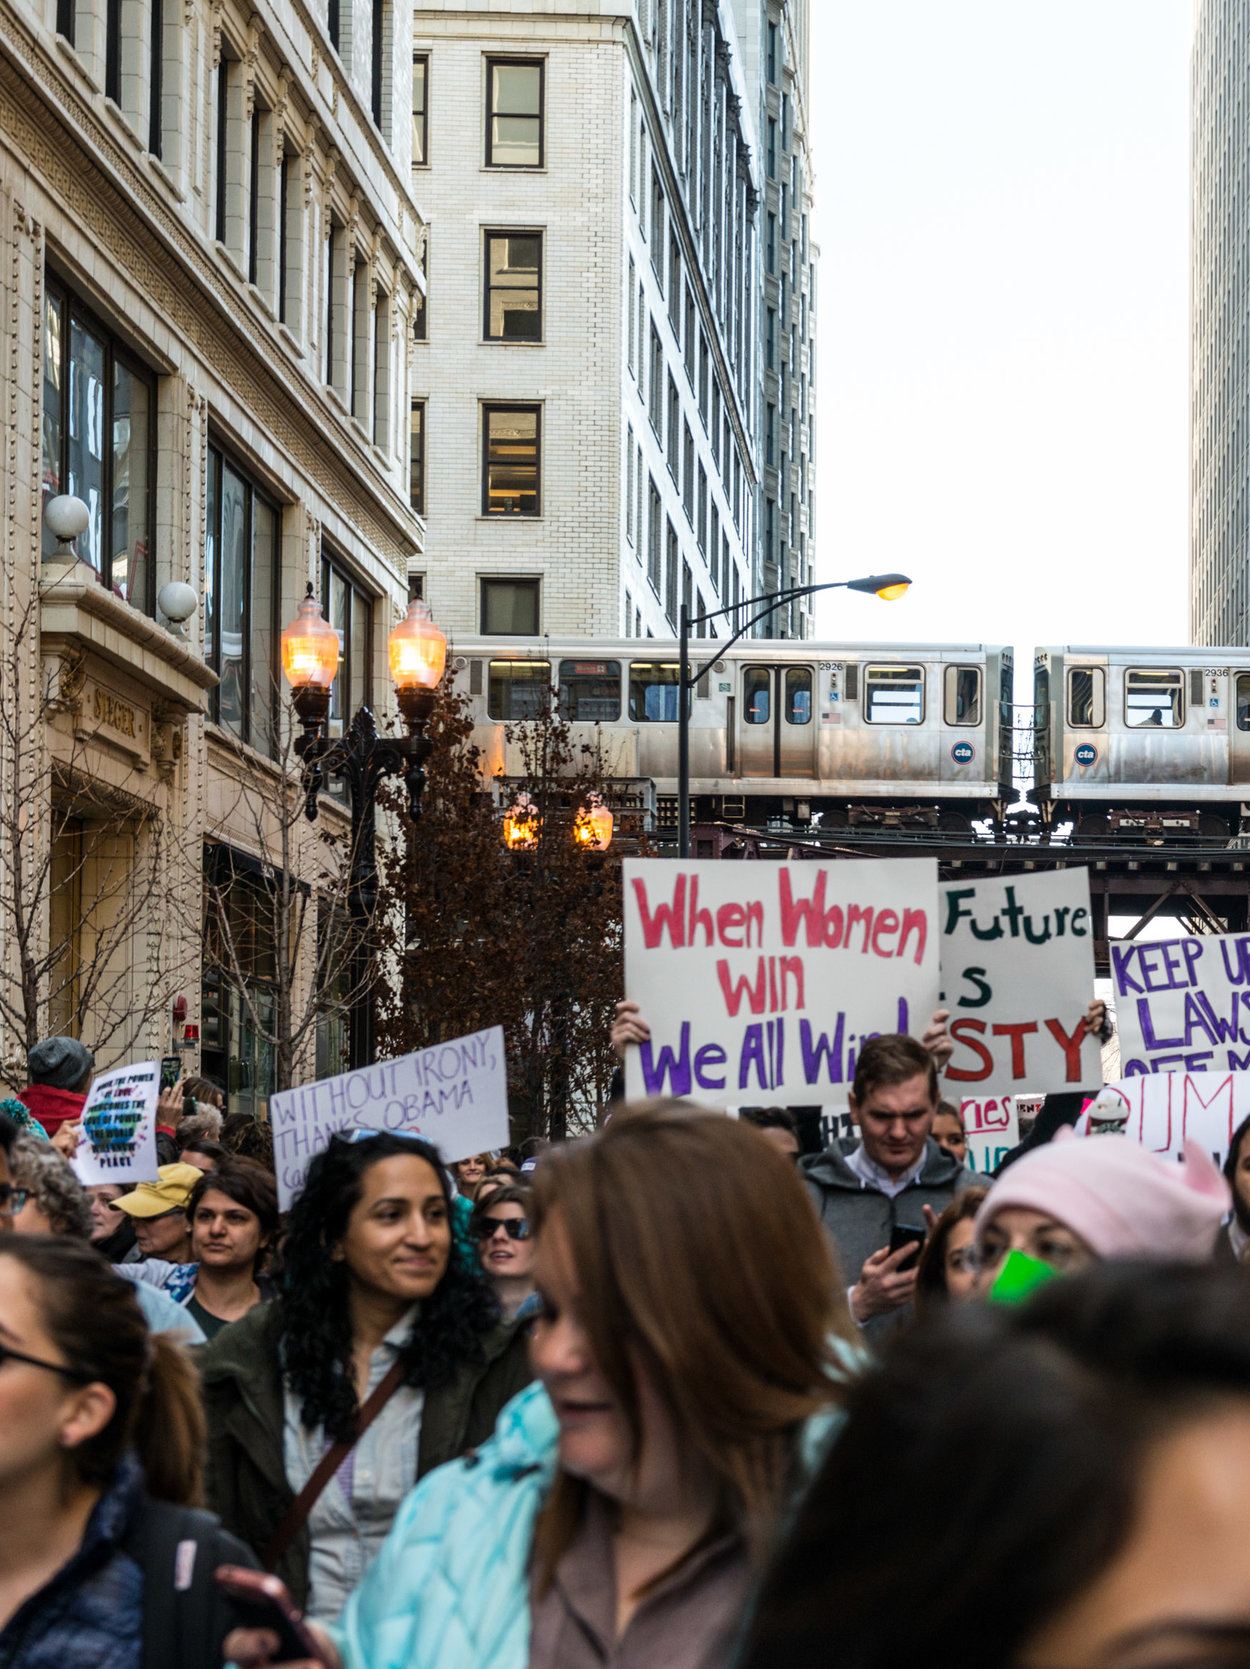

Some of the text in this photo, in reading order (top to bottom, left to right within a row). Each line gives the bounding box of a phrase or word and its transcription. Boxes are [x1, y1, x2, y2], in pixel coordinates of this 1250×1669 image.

[819, 662, 843, 671] 2926
[1205, 669, 1228, 677] 2936
[955, 748, 971, 756] cta
[1078, 750, 1094, 758] cta
[631, 867, 927, 965] When Women
[944, 886, 1088, 945] Future
[1111, 937, 1203, 996] KEEP
[640, 1021, 727, 1097] We
[739, 1017, 784, 1091] All
[944, 1016, 1087, 1083] STY
[127, 1073, 154, 1083] POWER
[274, 1032, 497, 1126] WITHOUT IRONY,
[132, 1100, 146, 1109] THE
[960, 1096, 1011, 1129] ries
[114, 1113, 142, 1123] POWER
[275, 1079, 474, 1160] THANKS OBAMA
[100, 1156, 132, 1168] PEACE
